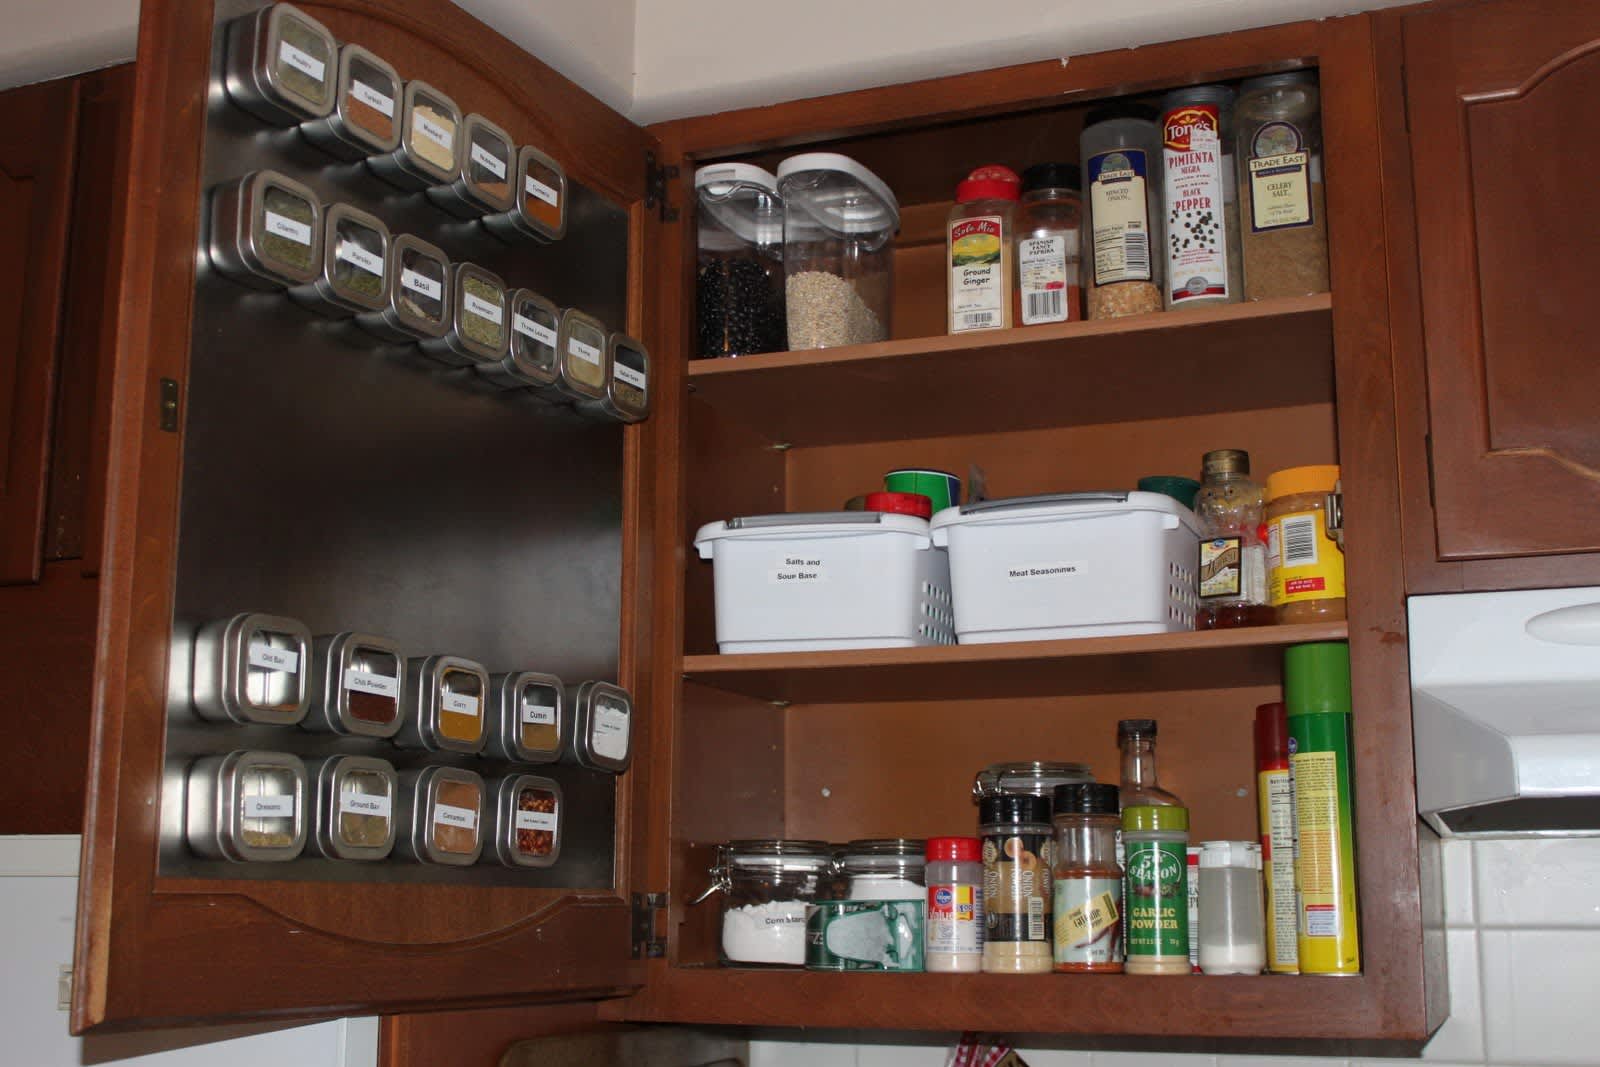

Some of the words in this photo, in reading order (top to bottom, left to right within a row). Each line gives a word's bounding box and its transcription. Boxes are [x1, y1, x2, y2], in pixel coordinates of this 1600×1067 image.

[1168, 120, 1210, 139] Tone's
[1168, 152, 1214, 168] PIMIENTA
[1252, 158, 1280, 169] TRADE
[1282, 155, 1303, 165] EAST
[1266, 182, 1292, 191] CELERY
[1182, 188, 1201, 197] BLACK
[1272, 190, 1288, 198] SALT
[1175, 197, 1211, 213] PEPPER
[963, 267, 991, 277] Ground
[414, 278, 430, 291] Basil
[963, 278, 990, 286] Ginger
[785, 558, 804, 566] Salts
[1009, 569, 1028, 577] Meat
[1030, 565, 1076, 576] Seasonings
[530, 711, 548, 720] Cumin
[1130, 863, 1177, 881] SEASON
[1022, 871, 1034, 898] ONION
[1132, 908, 1176, 917] GARLIC
[766, 917, 784, 925] Corn
[1131, 919, 1178, 929] POWDER
